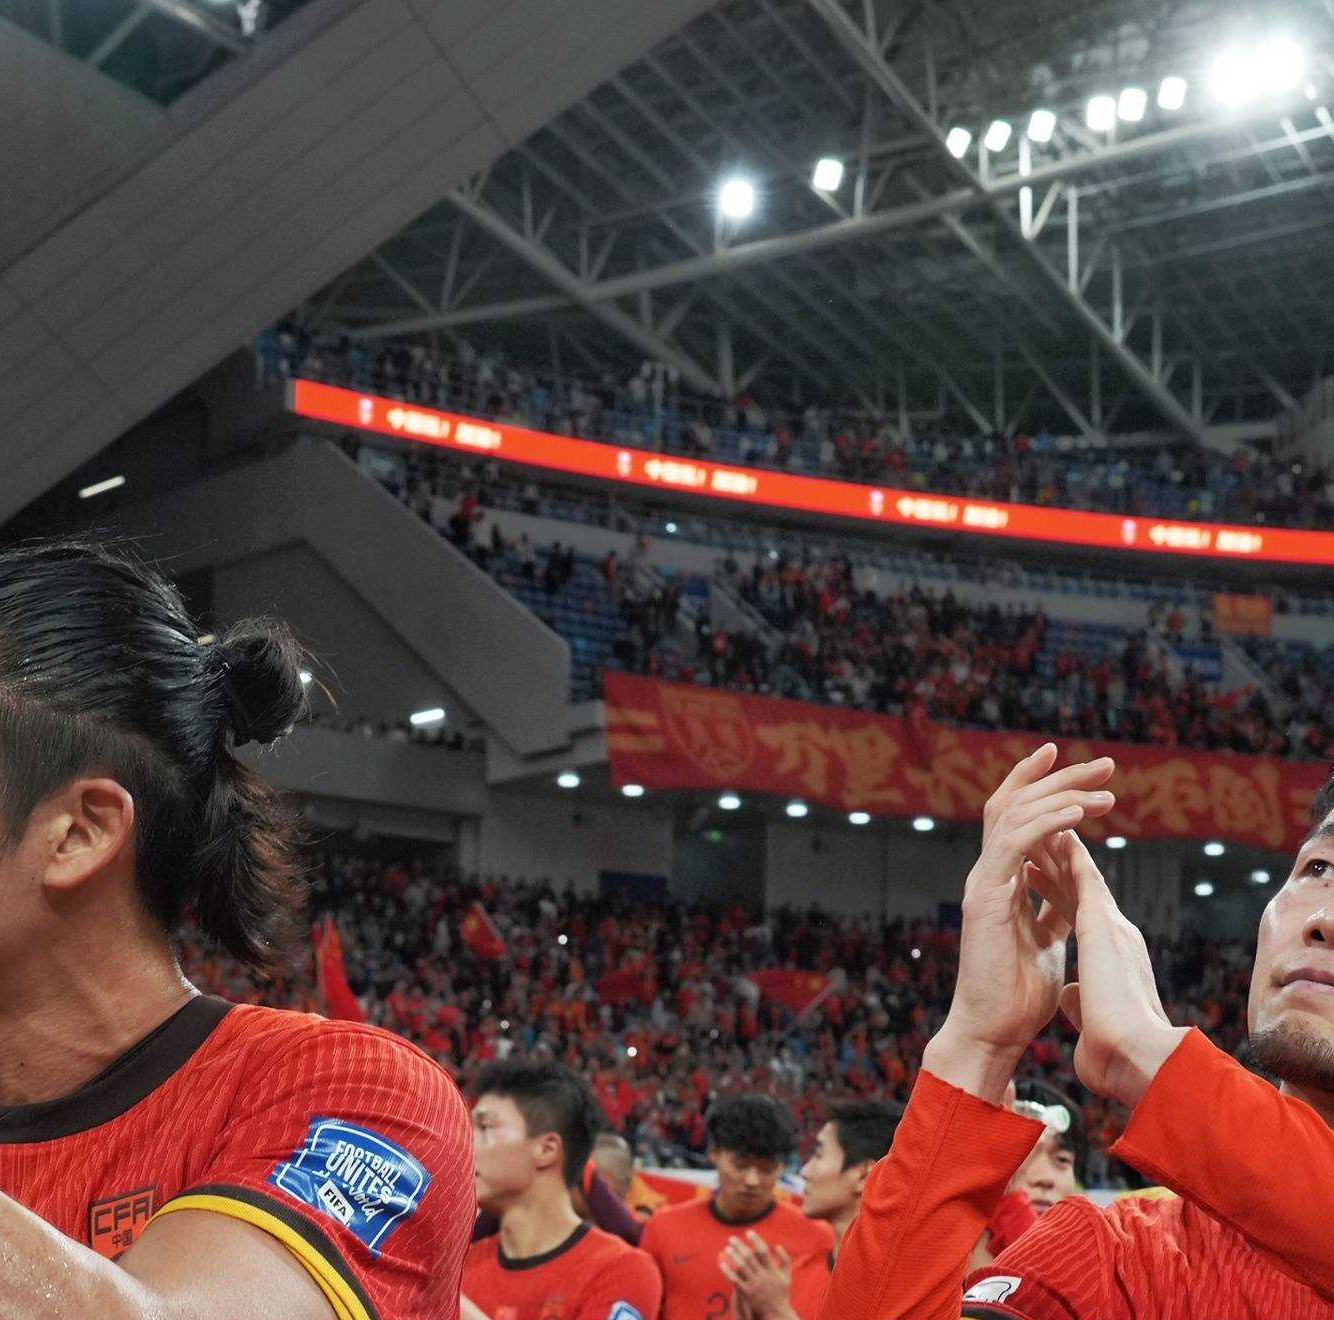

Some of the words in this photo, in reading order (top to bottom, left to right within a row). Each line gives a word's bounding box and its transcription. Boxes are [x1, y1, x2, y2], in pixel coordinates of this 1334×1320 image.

[326, 1152, 393, 1204] UNITES
[334, 1140, 401, 1189] FOOTBALL
[95, 1196, 149, 1235] CFA
[324, 1188, 347, 1217] FIFA
[112, 1229, 133, 1249] 中国
